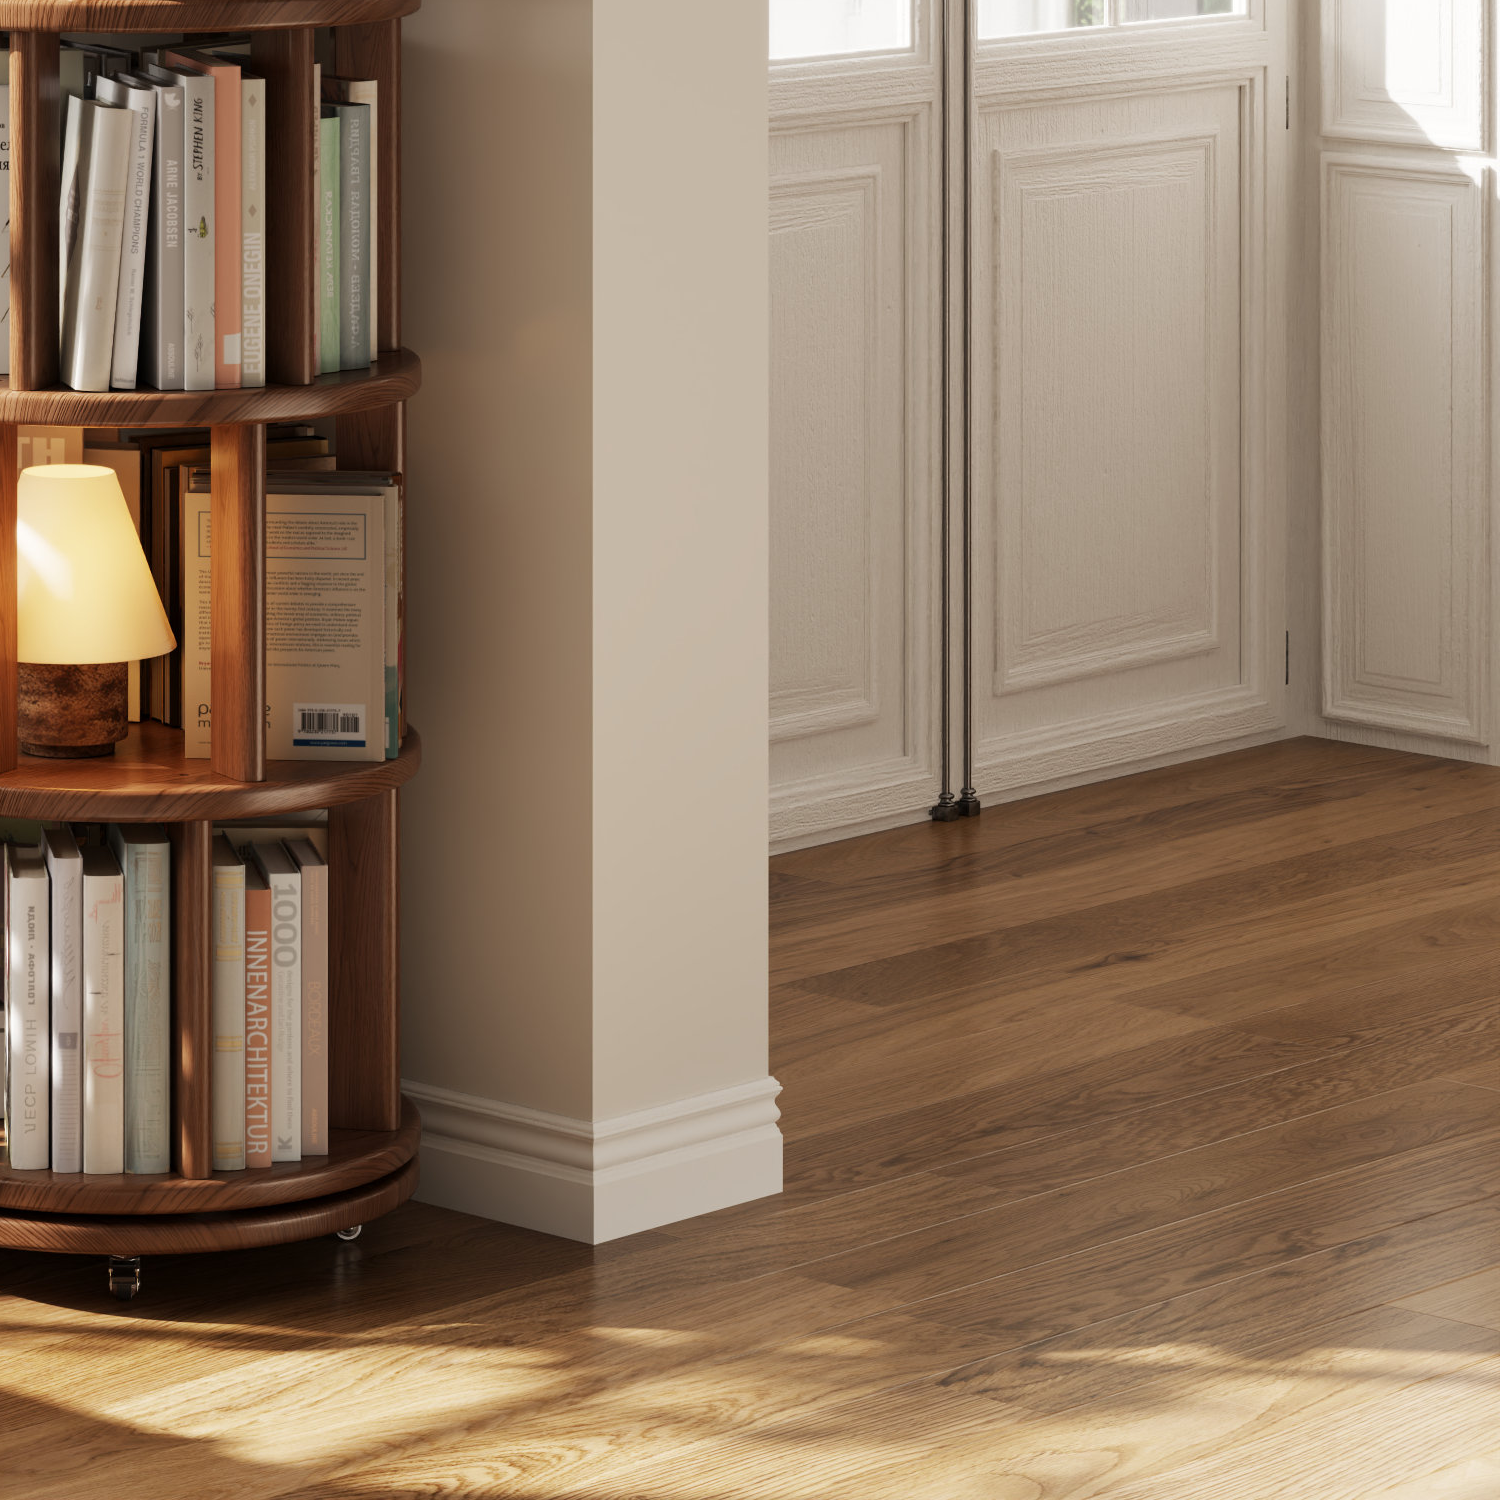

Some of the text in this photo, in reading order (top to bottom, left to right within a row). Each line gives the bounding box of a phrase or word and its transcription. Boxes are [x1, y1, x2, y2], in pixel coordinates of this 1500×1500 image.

[139, 106, 149, 152] FORMULA
[193, 98, 203, 124] KING
[193, 126, 204, 171] STEPHEN
[135, 162, 145, 197] WORLD
[166, 160, 178, 248] ARNE JACOBSEN
[131, 200, 142, 254] CHAMPIONS
[243, 232, 261, 374] EUGENE ONEGIN
[272, 883, 298, 968] 1000
[285, 970, 294, 993] designs
[246, 930, 269, 1154] INNENARCHITEKTUR
[308, 981, 322, 1057] BORDEAUX
